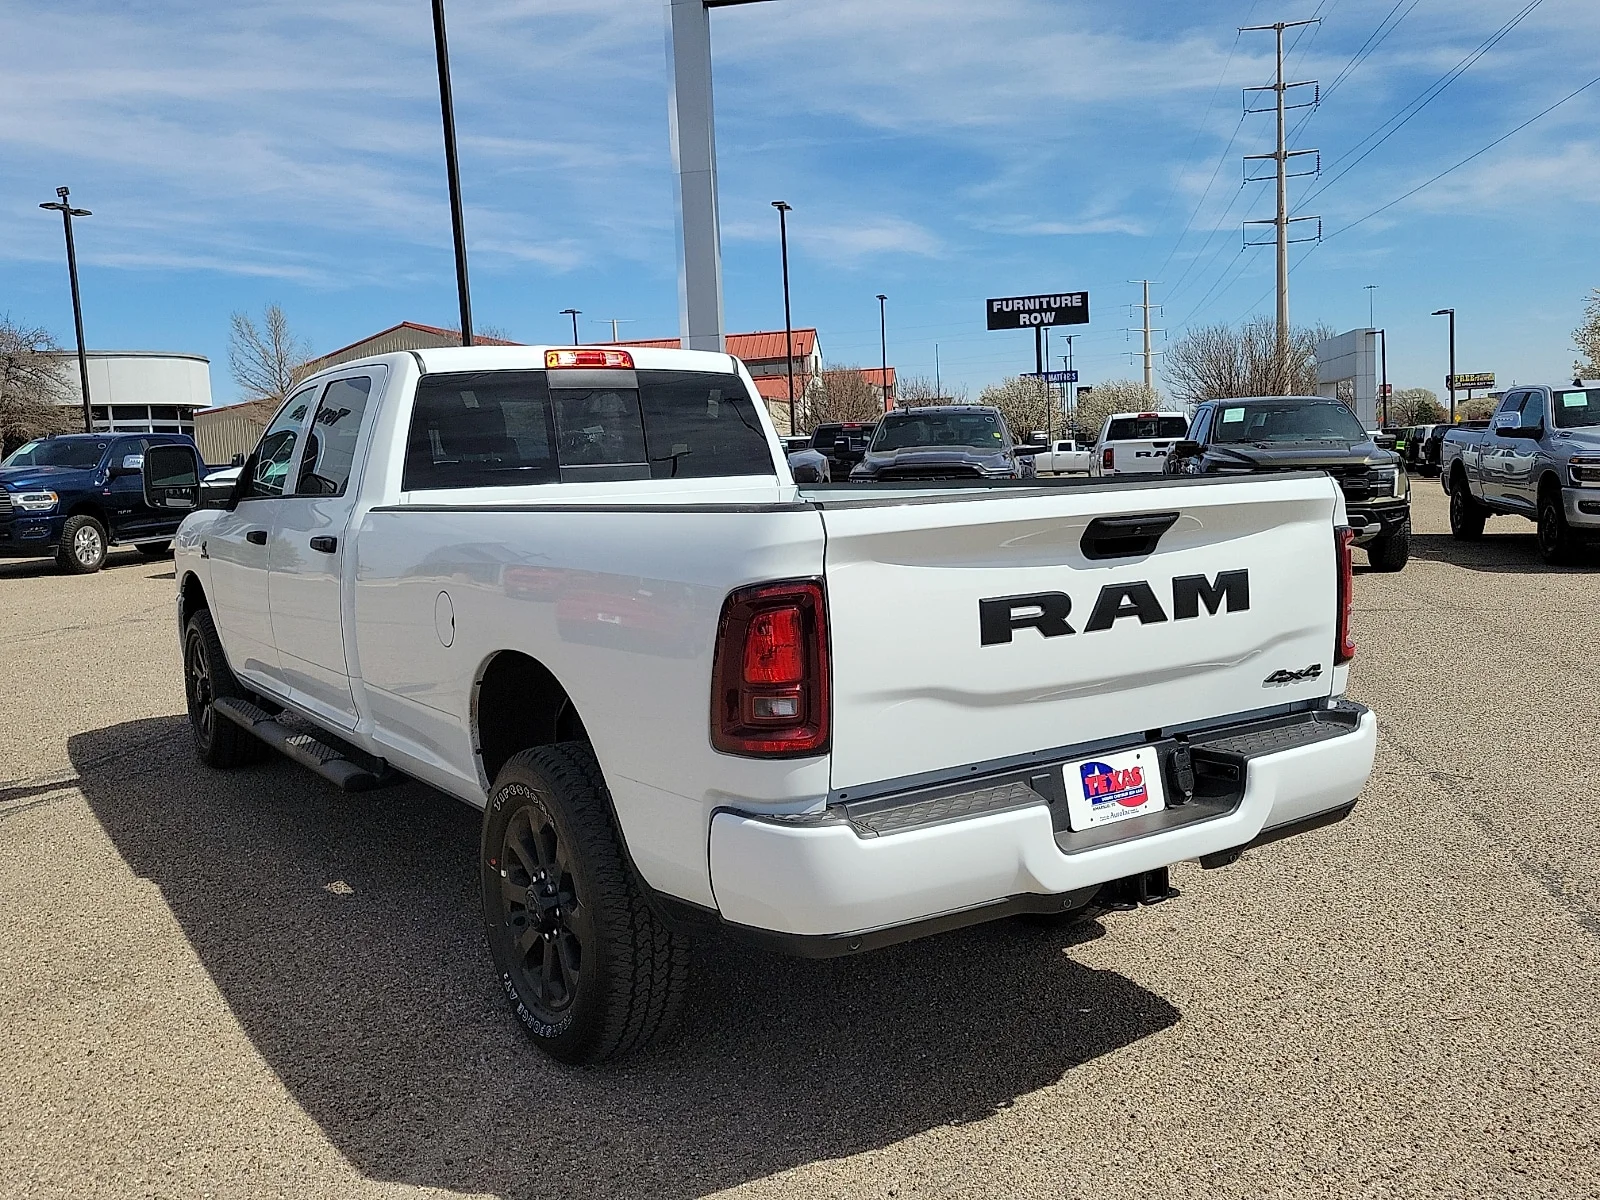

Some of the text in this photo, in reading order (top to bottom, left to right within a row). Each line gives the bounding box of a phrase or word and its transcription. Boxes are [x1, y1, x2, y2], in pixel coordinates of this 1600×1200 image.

[993, 295, 1082, 313] FURNITURE
[1020, 312, 1056, 325] ROW
[1135, 450, 1168, 458] RA
[979, 568, 1251, 648] RAM
[1085, 767, 1142, 796] TEXAS
